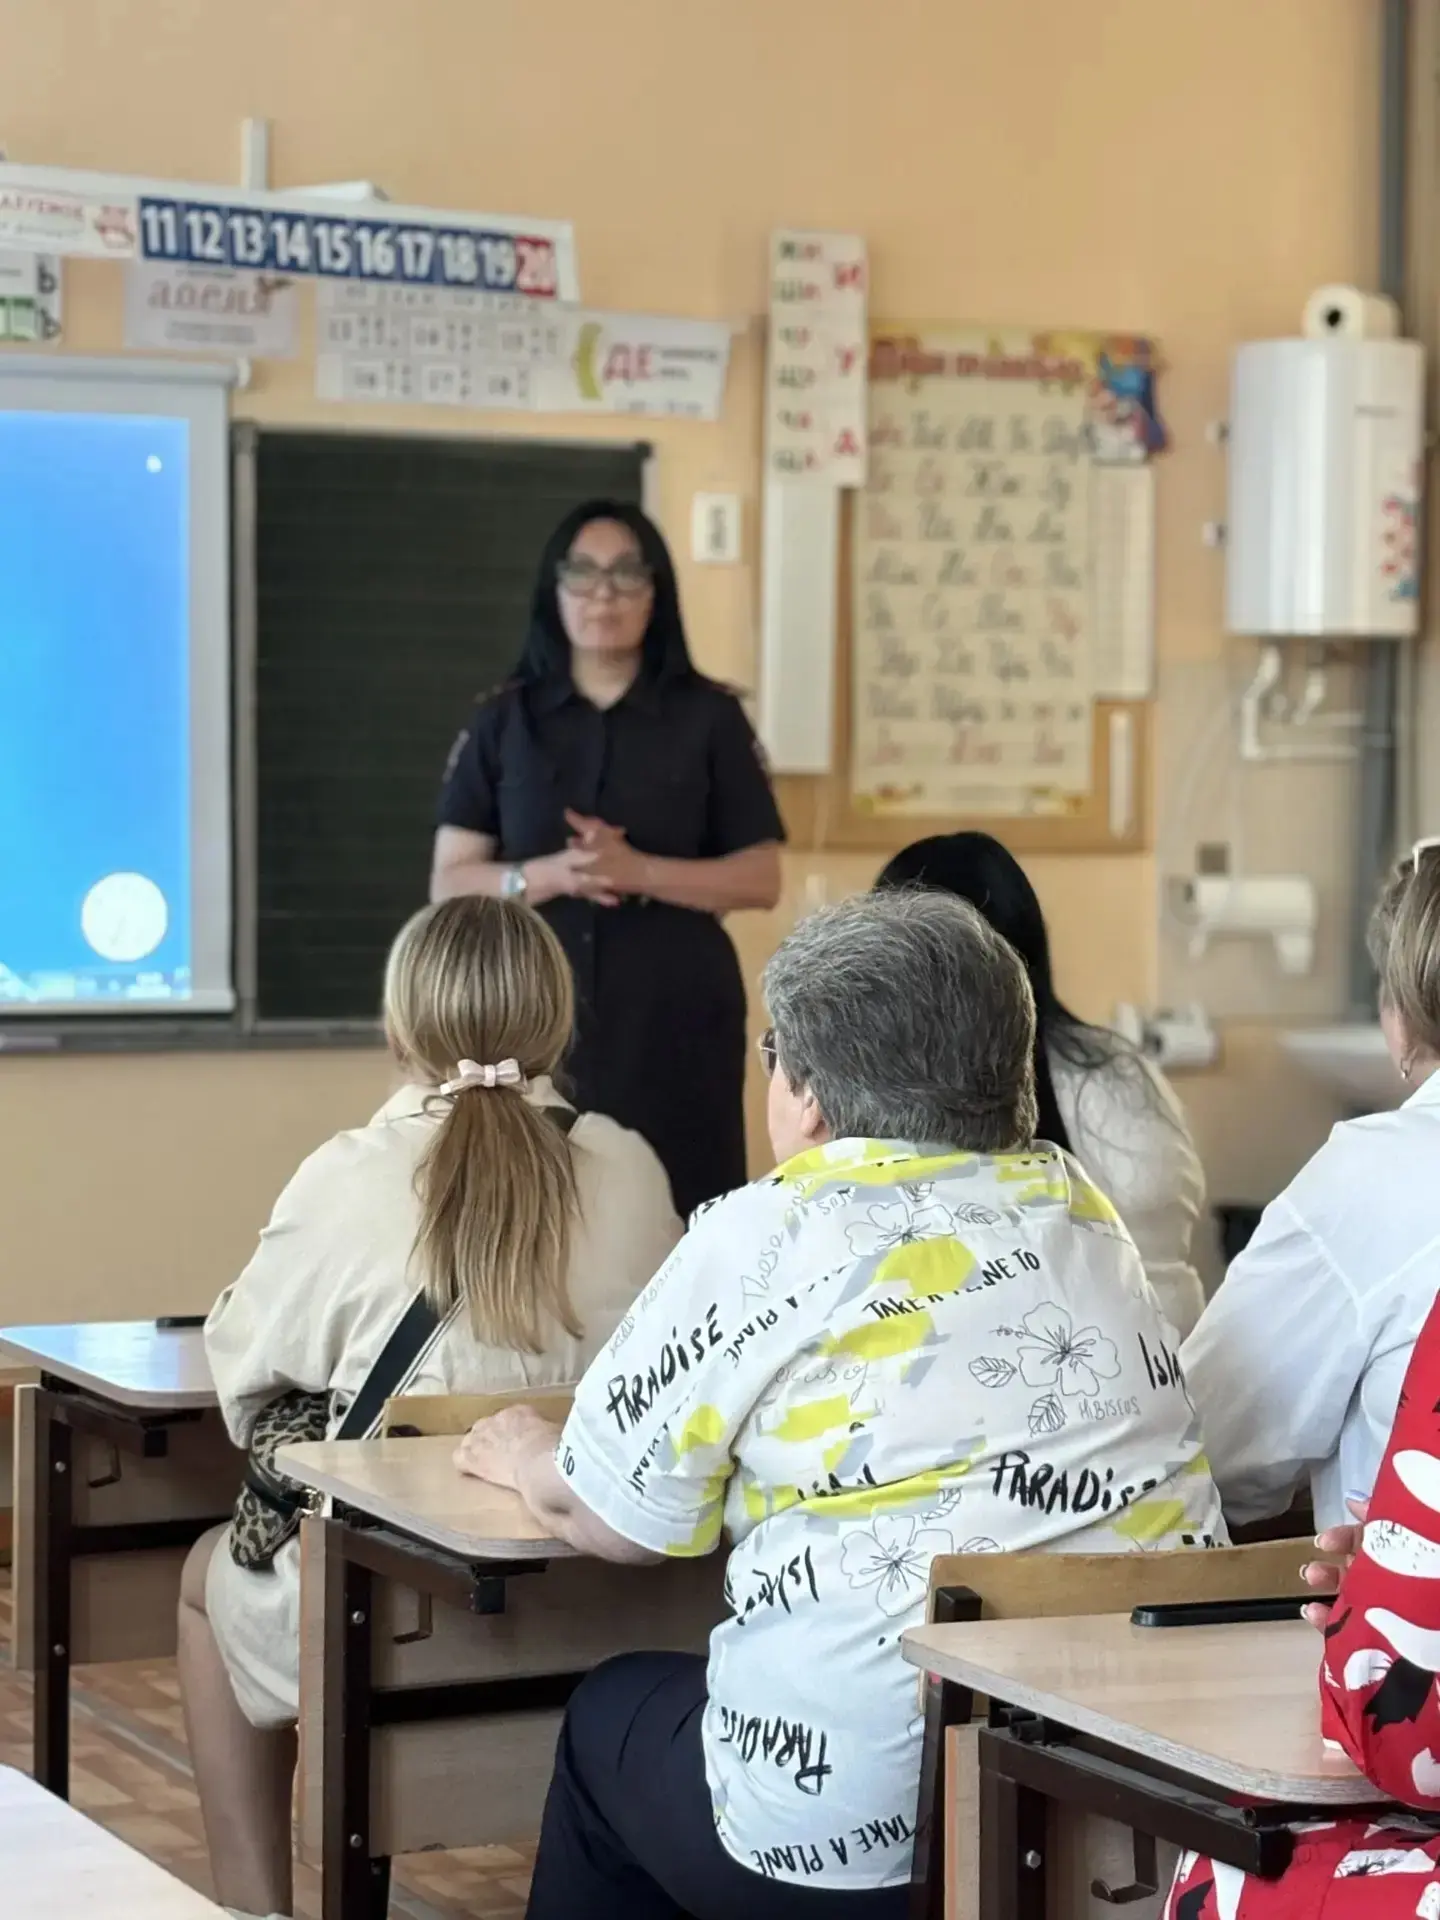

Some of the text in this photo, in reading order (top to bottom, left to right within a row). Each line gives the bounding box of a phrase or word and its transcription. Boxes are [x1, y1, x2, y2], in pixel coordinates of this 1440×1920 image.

[142, 205, 177, 256] 11
[185, 209, 224, 260] 12
[228, 214, 265, 265] 13
[271, 219, 310, 269] 14
[314, 223, 351, 274] 15
[355, 228, 395, 277] 16
[398, 234, 434, 281] 17
[441, 239, 479, 285] 18
[482, 244, 514, 289] 19
[1011, 1248, 1041, 1272] TO
[750, 1813, 917, 1878] TAKE A PLANE
